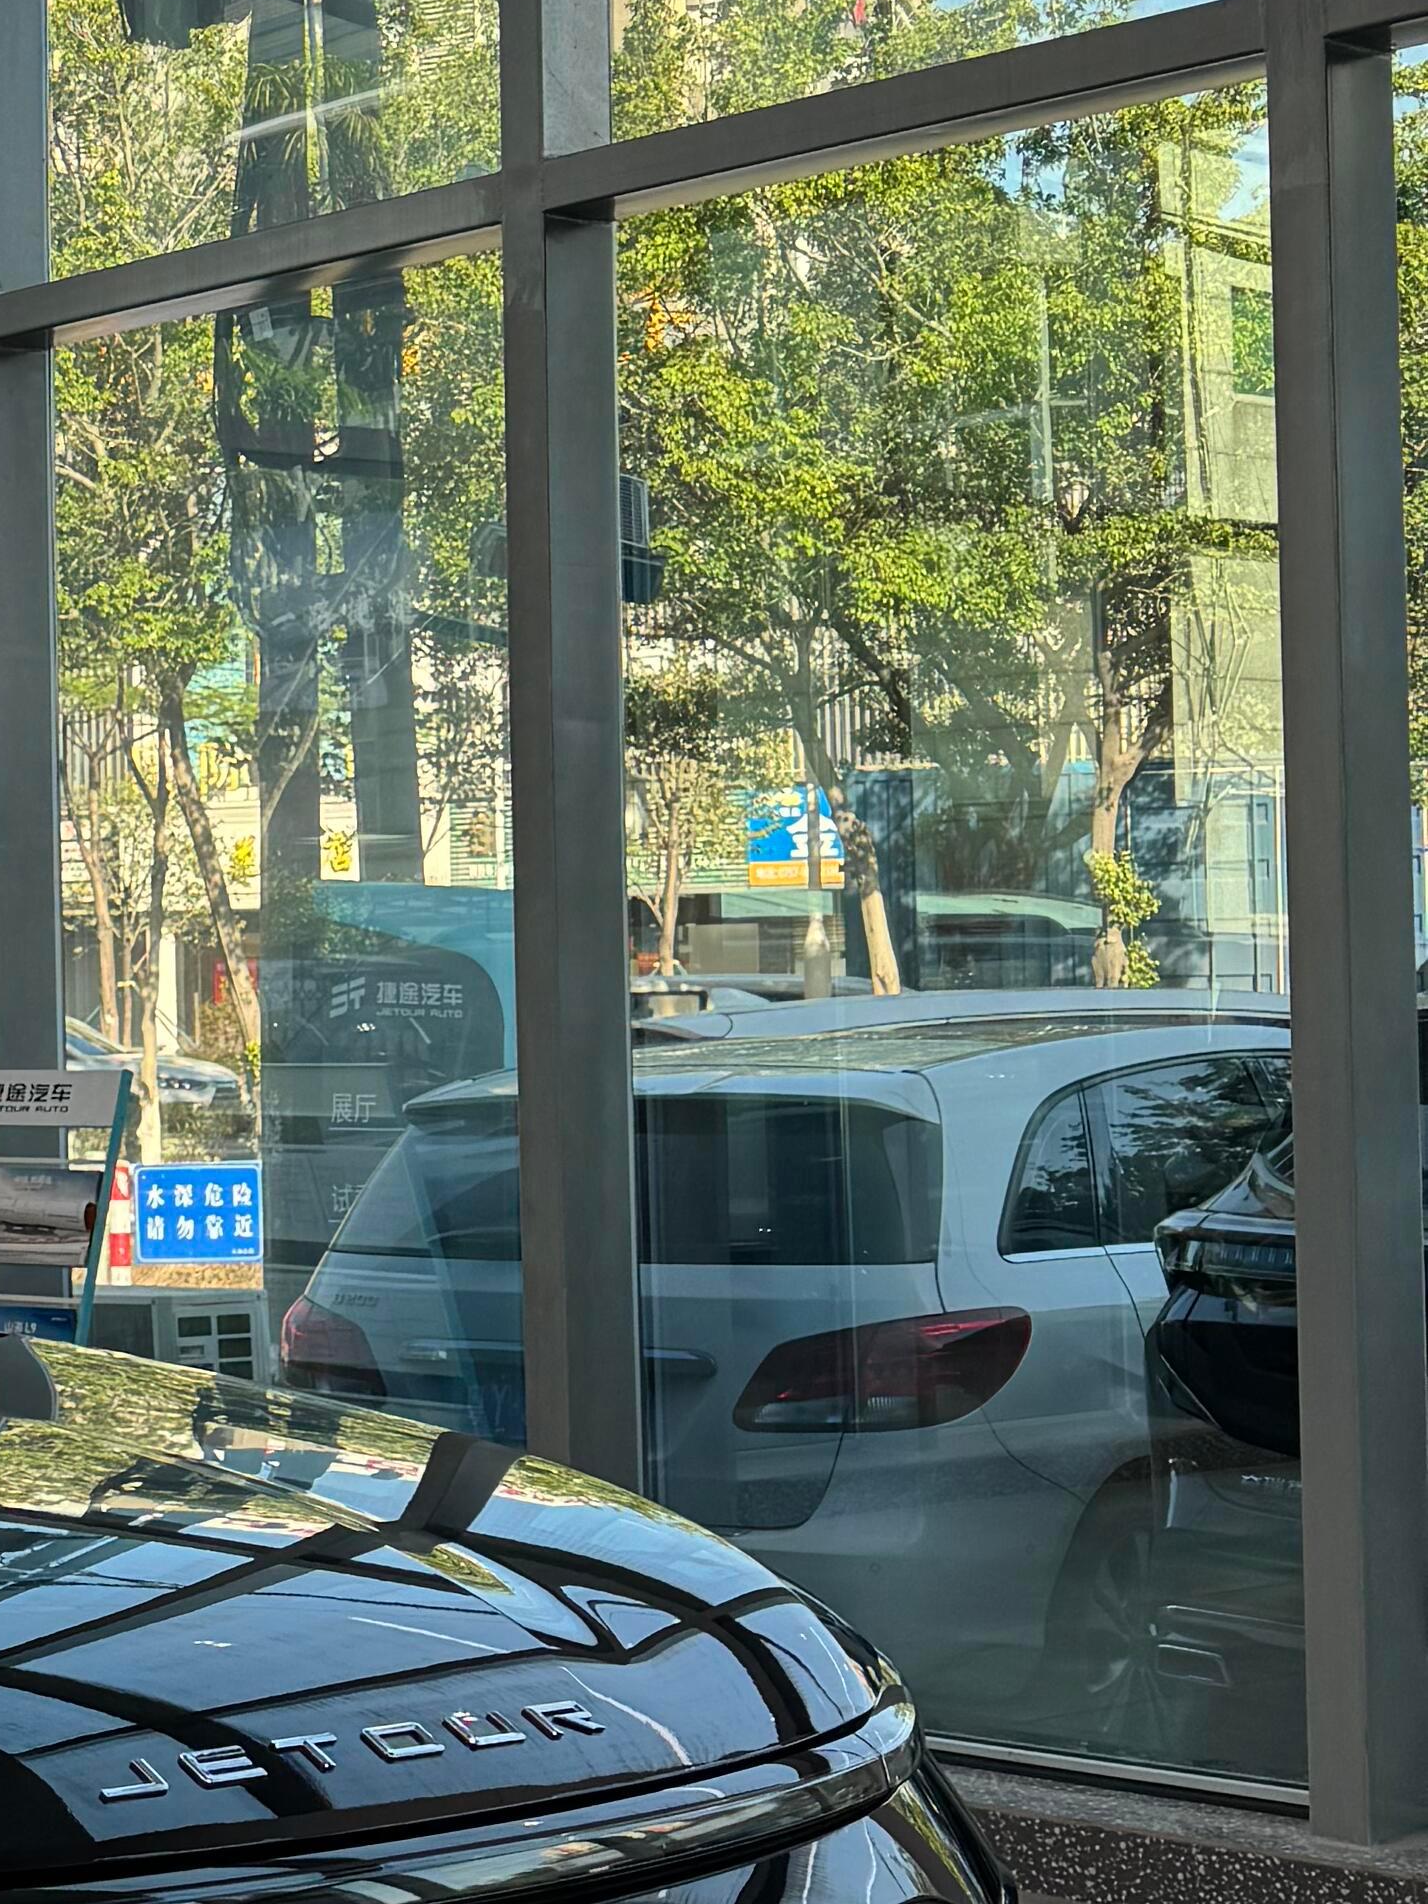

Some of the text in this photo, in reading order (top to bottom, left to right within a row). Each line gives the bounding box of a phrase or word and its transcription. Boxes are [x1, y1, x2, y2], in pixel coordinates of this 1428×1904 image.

[377, 981, 463, 1007] 捷途汽车
[376, 1008, 463, 1018] JETOUR AUTO
[35, 1105, 69, 1113] AUTO
[331, 1094, 377, 1125] 展厅
[99, 1698, 607, 1804] JETOUR
